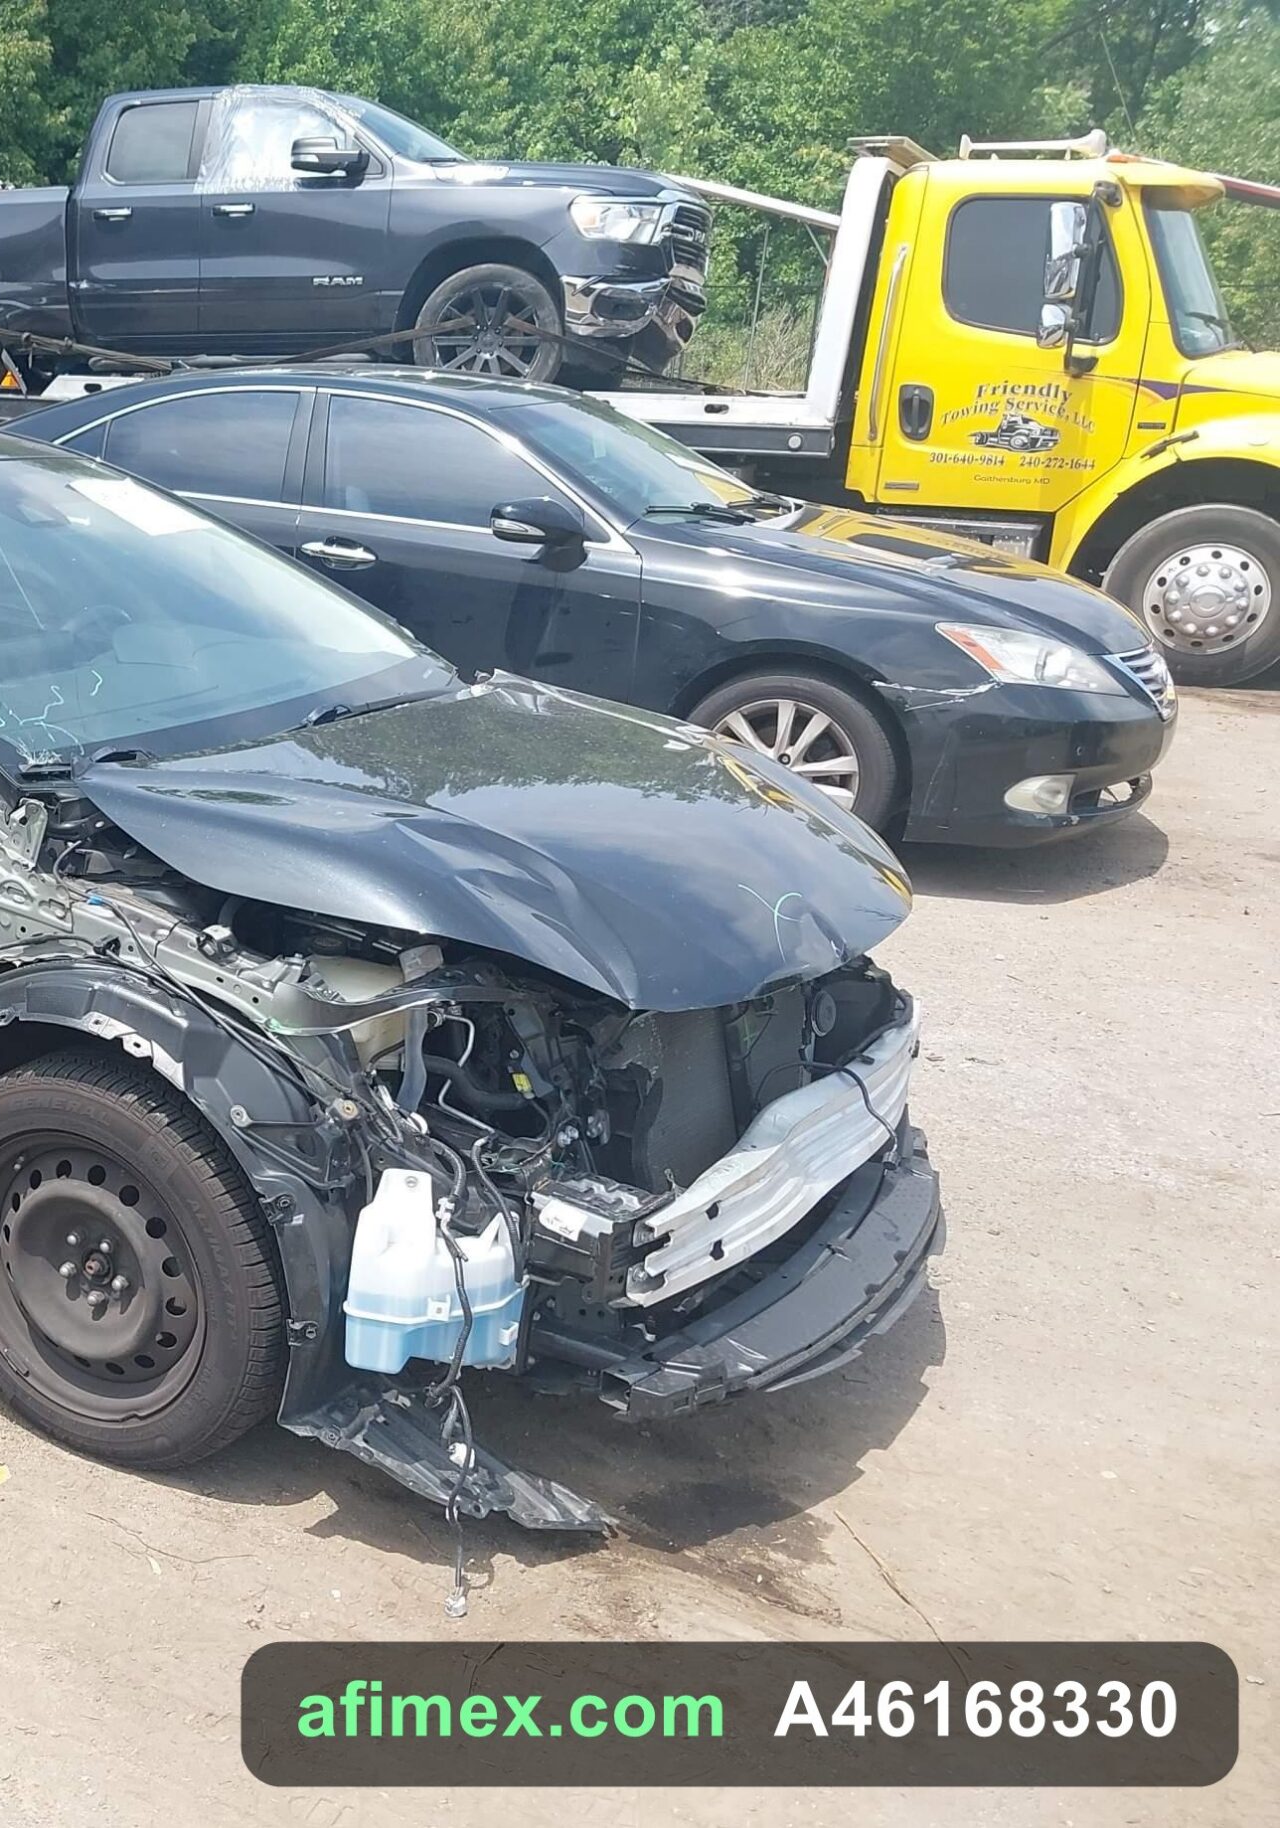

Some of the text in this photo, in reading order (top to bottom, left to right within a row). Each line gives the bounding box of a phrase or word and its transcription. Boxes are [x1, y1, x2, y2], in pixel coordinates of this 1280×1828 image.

[312, 276, 363, 286] RAM
[977, 380, 1072, 405] Friendly
[941, 398, 1095, 433] Towing Service, LLC
[929, 452, 1095, 470] 301-640-9814 240-272-1644
[1034, 477, 1051, 485] MD
